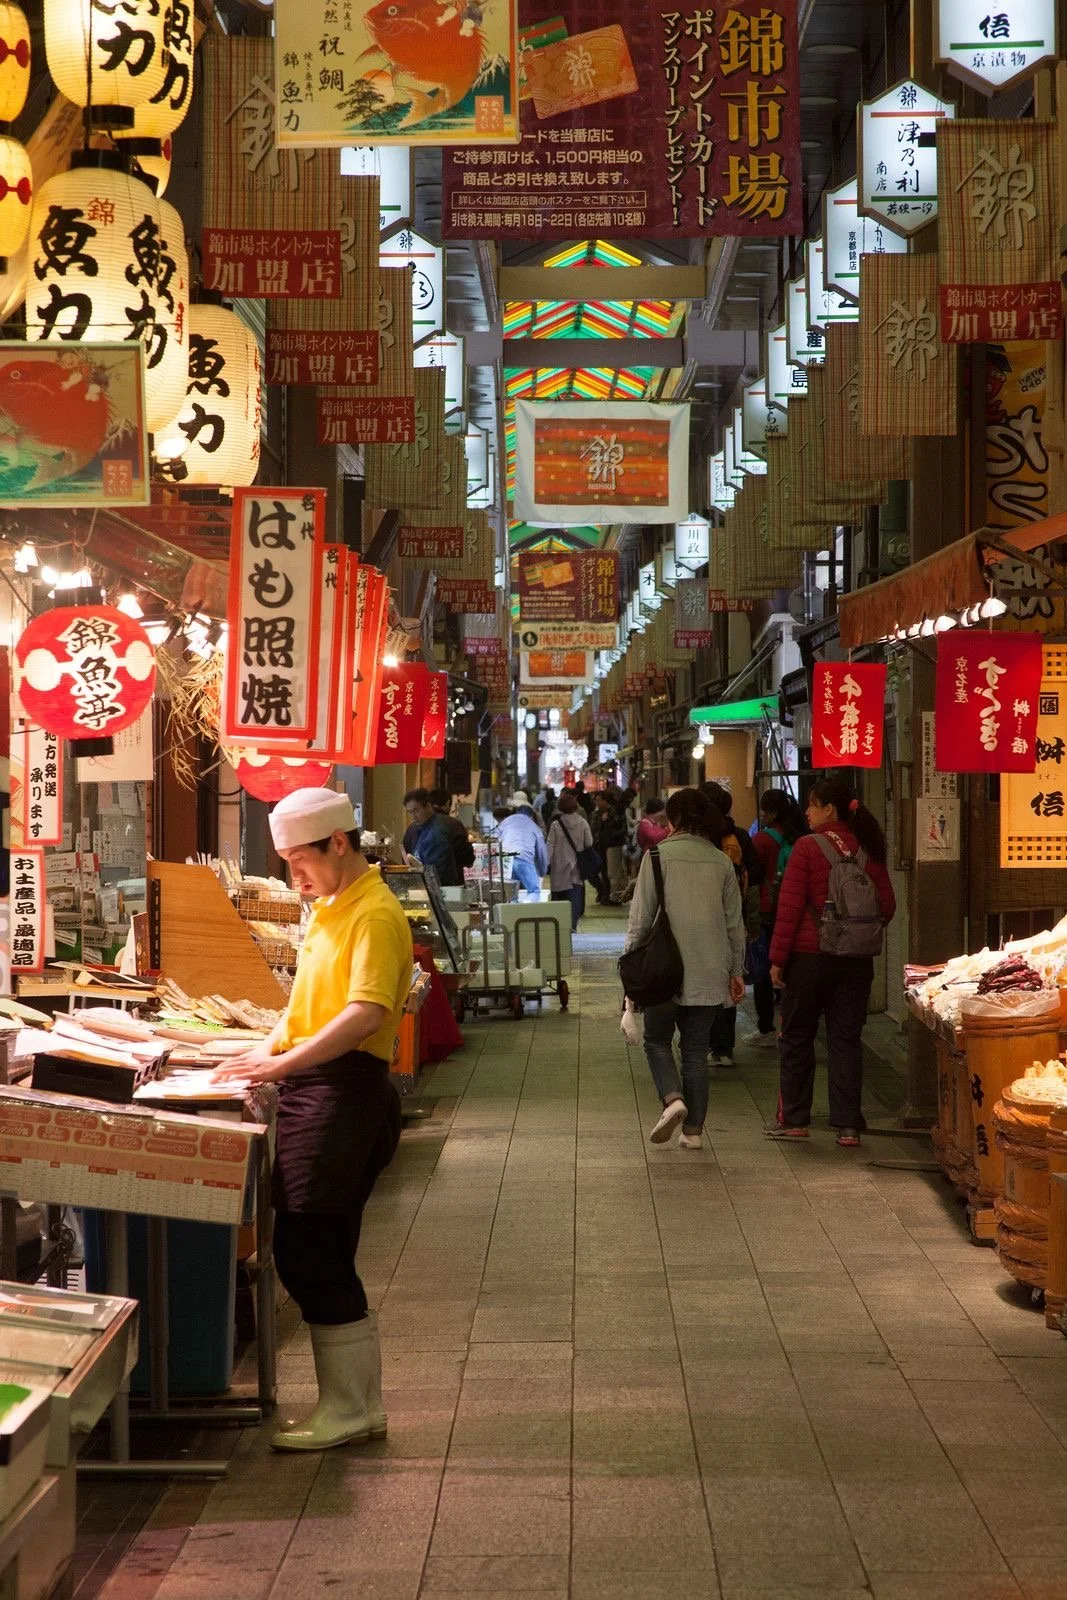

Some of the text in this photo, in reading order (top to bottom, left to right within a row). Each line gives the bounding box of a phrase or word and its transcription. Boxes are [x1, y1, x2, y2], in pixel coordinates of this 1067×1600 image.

[972, 52, 1027, 67] 京漬物
[281, 51, 303, 132] 錦魚力
[897, 85, 917, 109] 錦
[685, 10, 718, 227] ポイントカード
[718, 9, 788, 220] 錦市場
[518, 128, 615, 144] ードを当番店に
[452, 150, 643, 166] ご持参頂けば、1,500円相当の
[895, 121, 921, 193] 津乃利
[463, 171, 629, 187] 商品とお引き換え致します。
[876, 161, 887, 191] 南店
[87, 197, 116, 227] 錦
[209, 233, 335, 256] 錦市場ポイントカード
[210, 257, 336, 295] 加盟店
[948, 309, 1058, 341] 加盟店
[269, 352, 373, 384] 加盟店
[178, 334, 230, 453] 魚力
[322, 416, 410, 441] 加盟店
[300, 494, 315, 541] 名代
[402, 541, 460, 556] 加盟店
[325, 549, 339, 589] 名代
[597, 558, 616, 617] 錦市場
[241, 500, 297, 726] はも照焼
[65, 618, 120, 728] 錦魚亭
[404, 681, 414, 715] 京名産
[430, 678, 440, 714] 京名産
[381, 681, 401, 749] すぐき
[30, 768, 43, 837] 承ります
